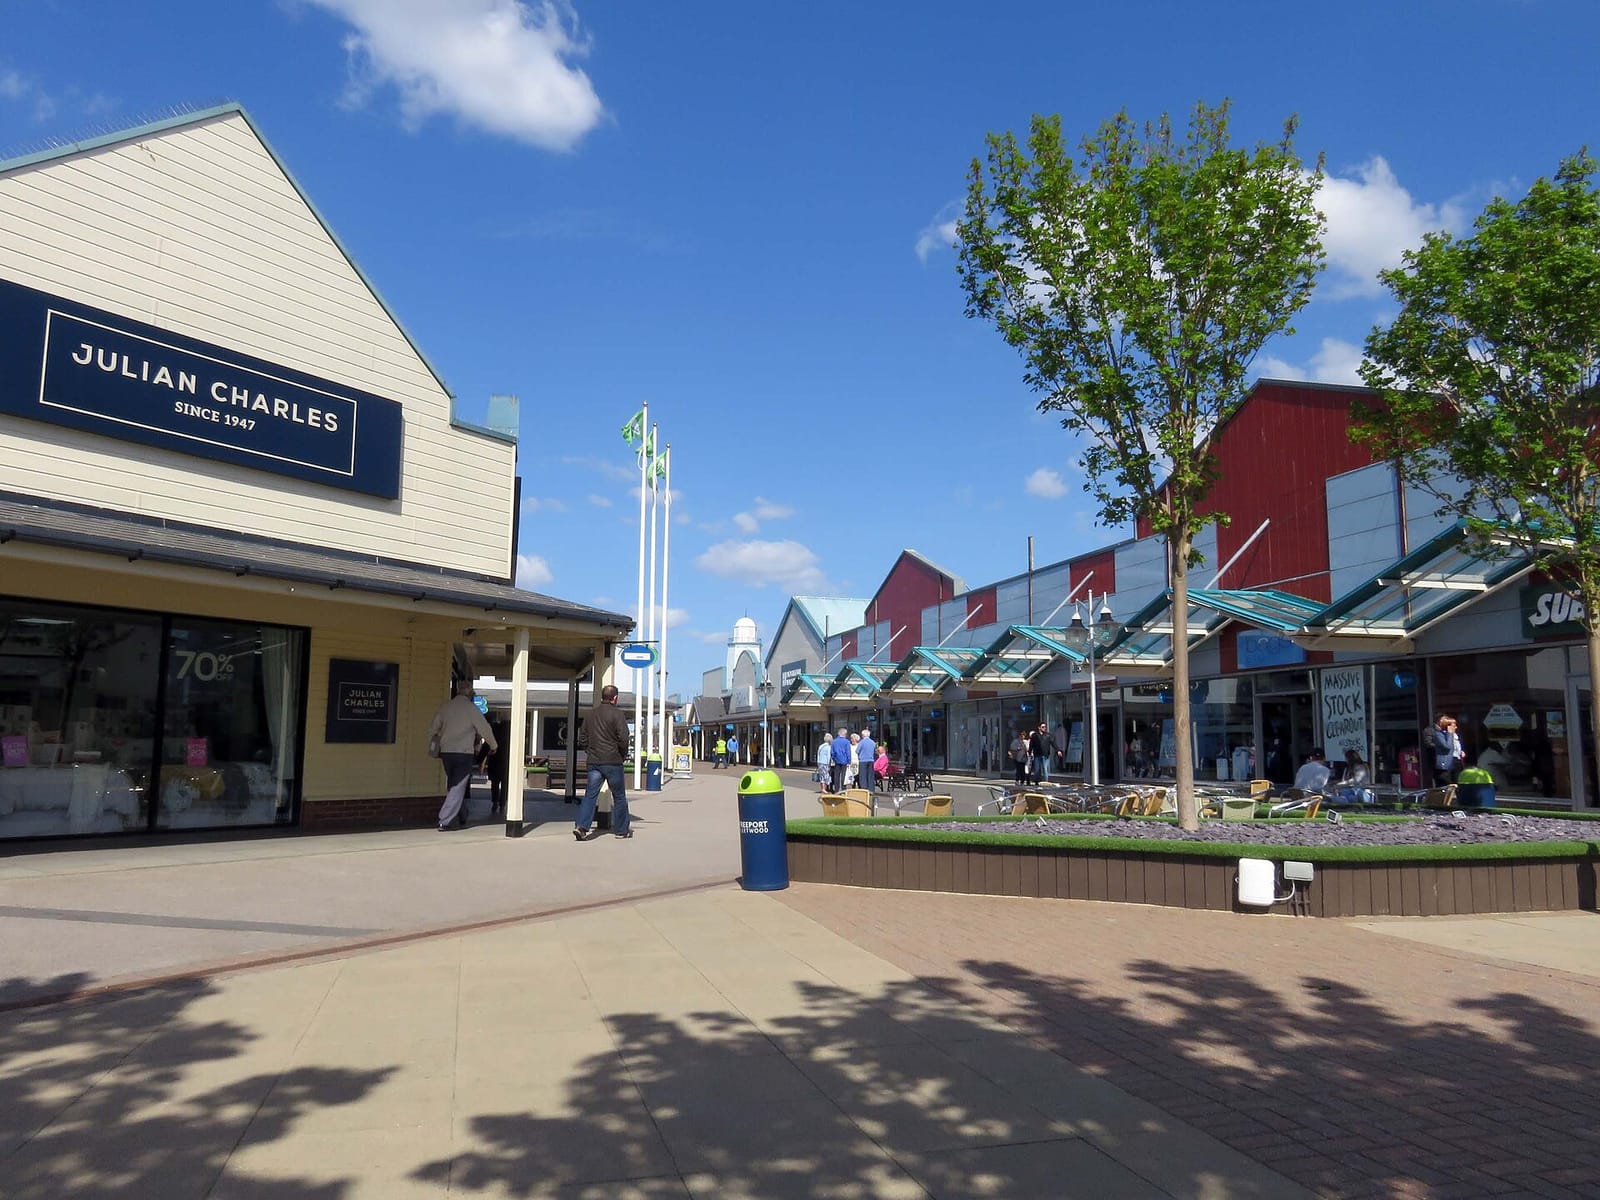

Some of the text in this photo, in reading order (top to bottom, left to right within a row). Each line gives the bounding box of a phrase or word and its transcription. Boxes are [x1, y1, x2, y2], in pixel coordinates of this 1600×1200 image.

[71, 343, 339, 433] JULIAN CHARLES
[174, 401, 256, 431] SINCE 1947
[175, 650, 234, 681] 70%
[1324, 671, 1361, 690] MASSIVE
[344, 698, 385, 708] CHARLES
[350, 689, 382, 699] JULIAN
[1324, 691, 1362, 720] STOCK
[1326, 716, 1364, 740] CLEAROUT
